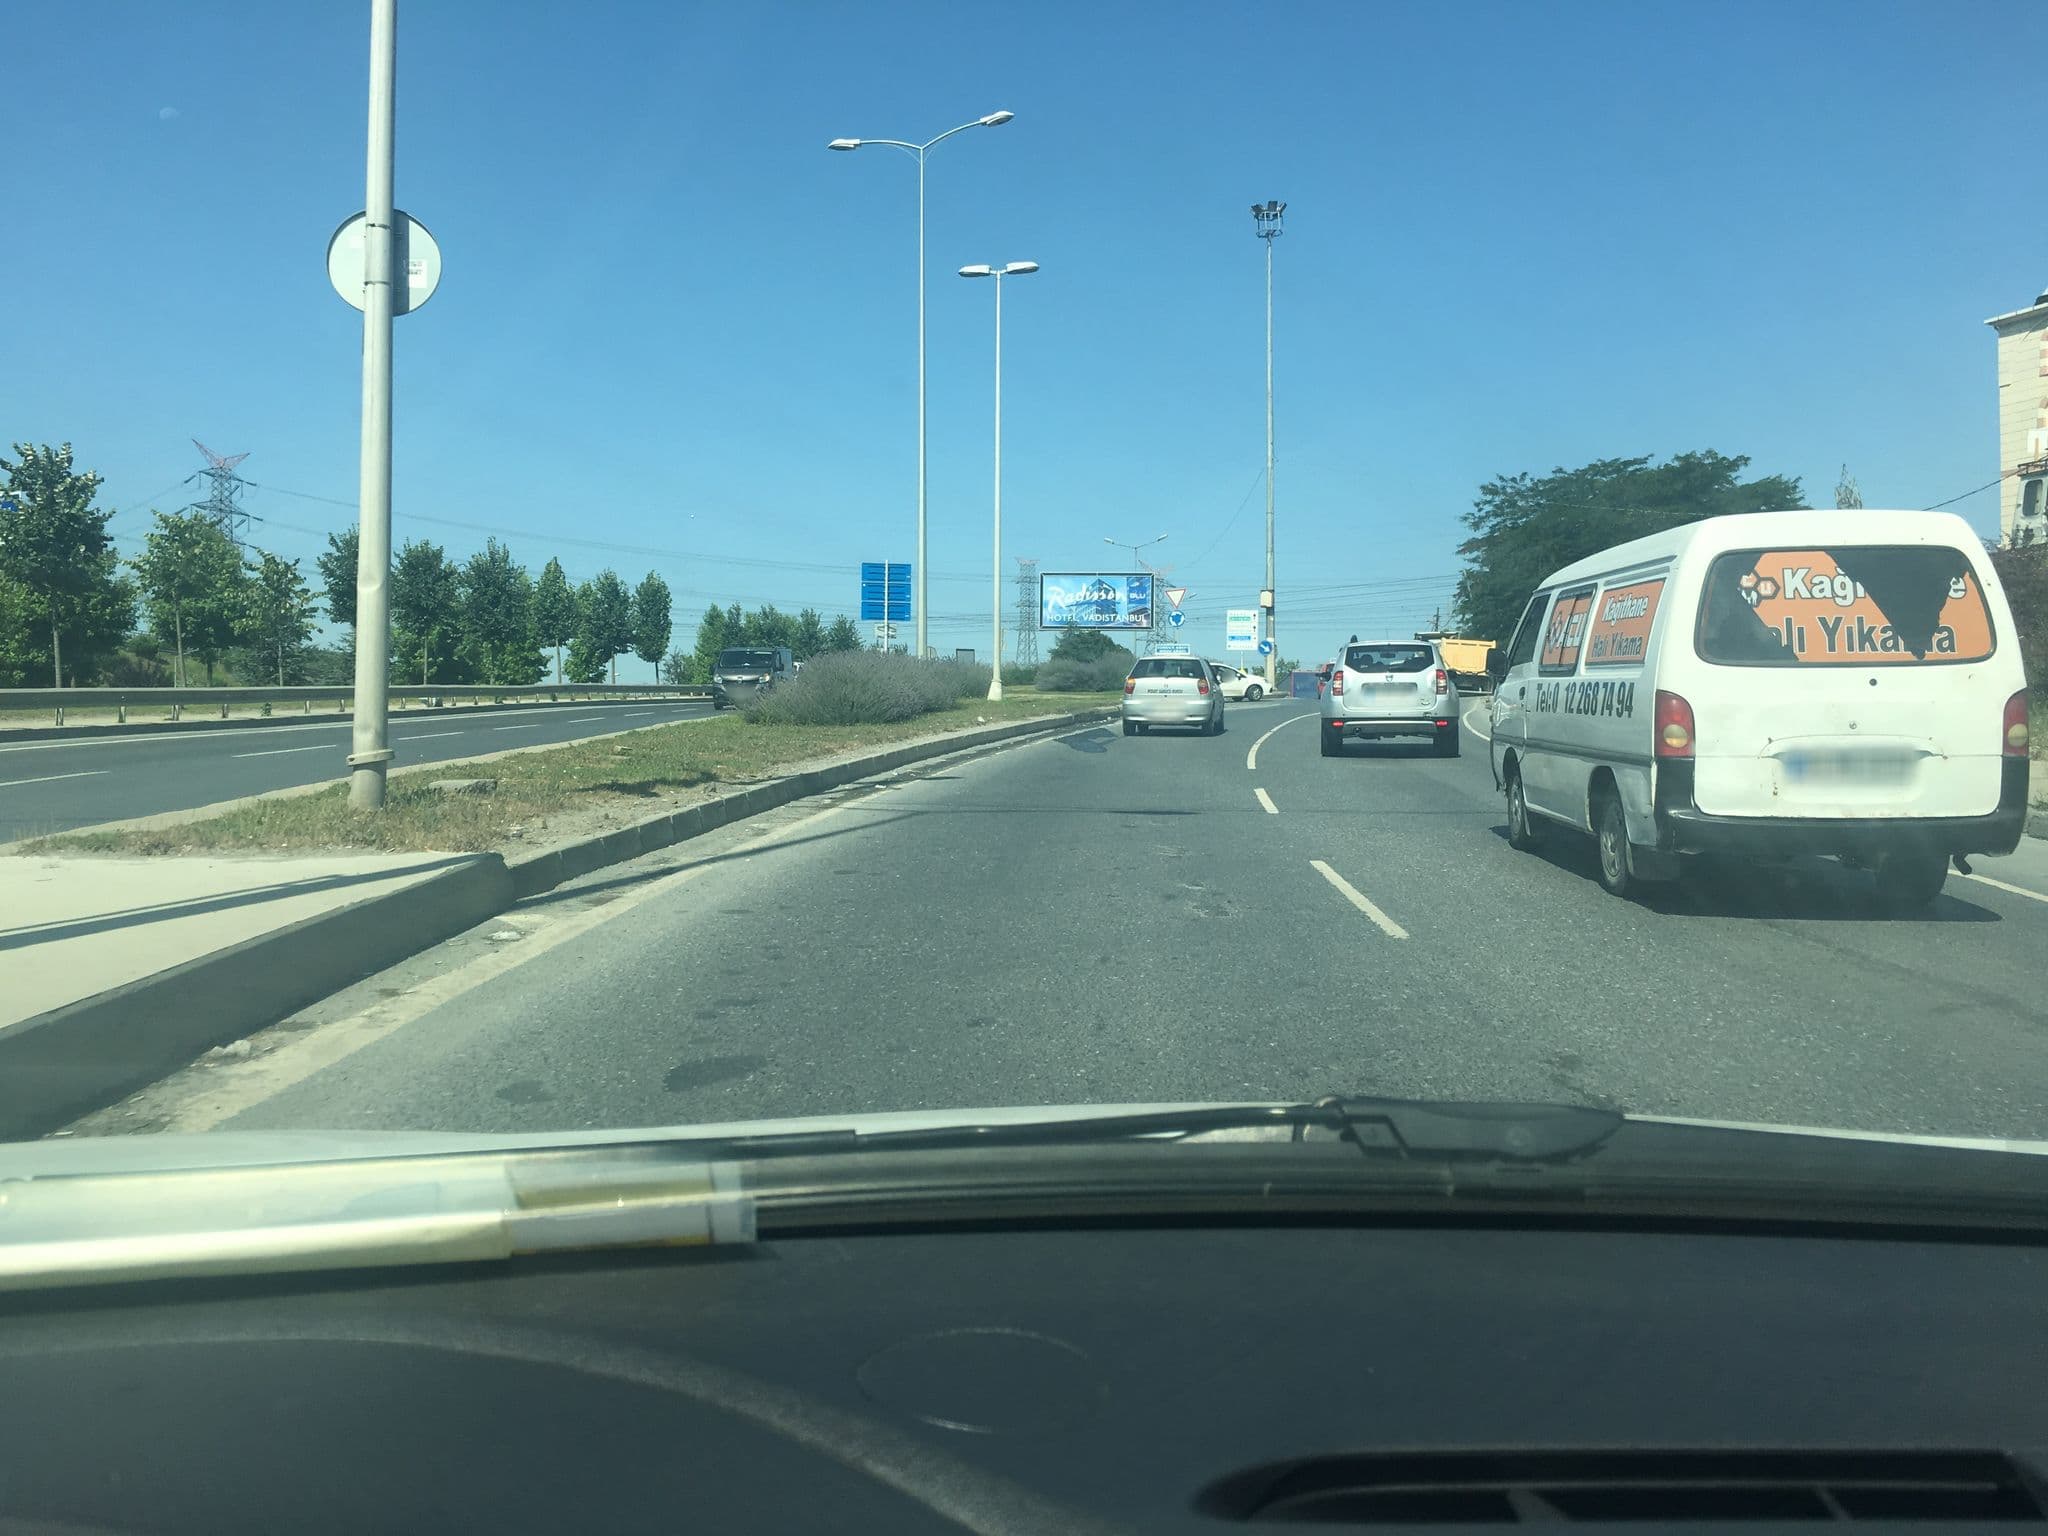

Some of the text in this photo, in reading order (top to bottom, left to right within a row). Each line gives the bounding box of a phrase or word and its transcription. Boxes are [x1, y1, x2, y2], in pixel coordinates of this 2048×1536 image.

[1047, 584, 1125, 612] Radisson
[1782, 567, 1967, 607] Kağıe
[1047, 613, 1080, 622] HOTEL
[1611, 632, 1643, 657] Yıkama
[1816, 615, 1958, 655] Yıkaa
[1576, 681, 1600, 716] 268
[1600, 682, 1616, 717] 74
[1616, 681, 1635, 718] 94
